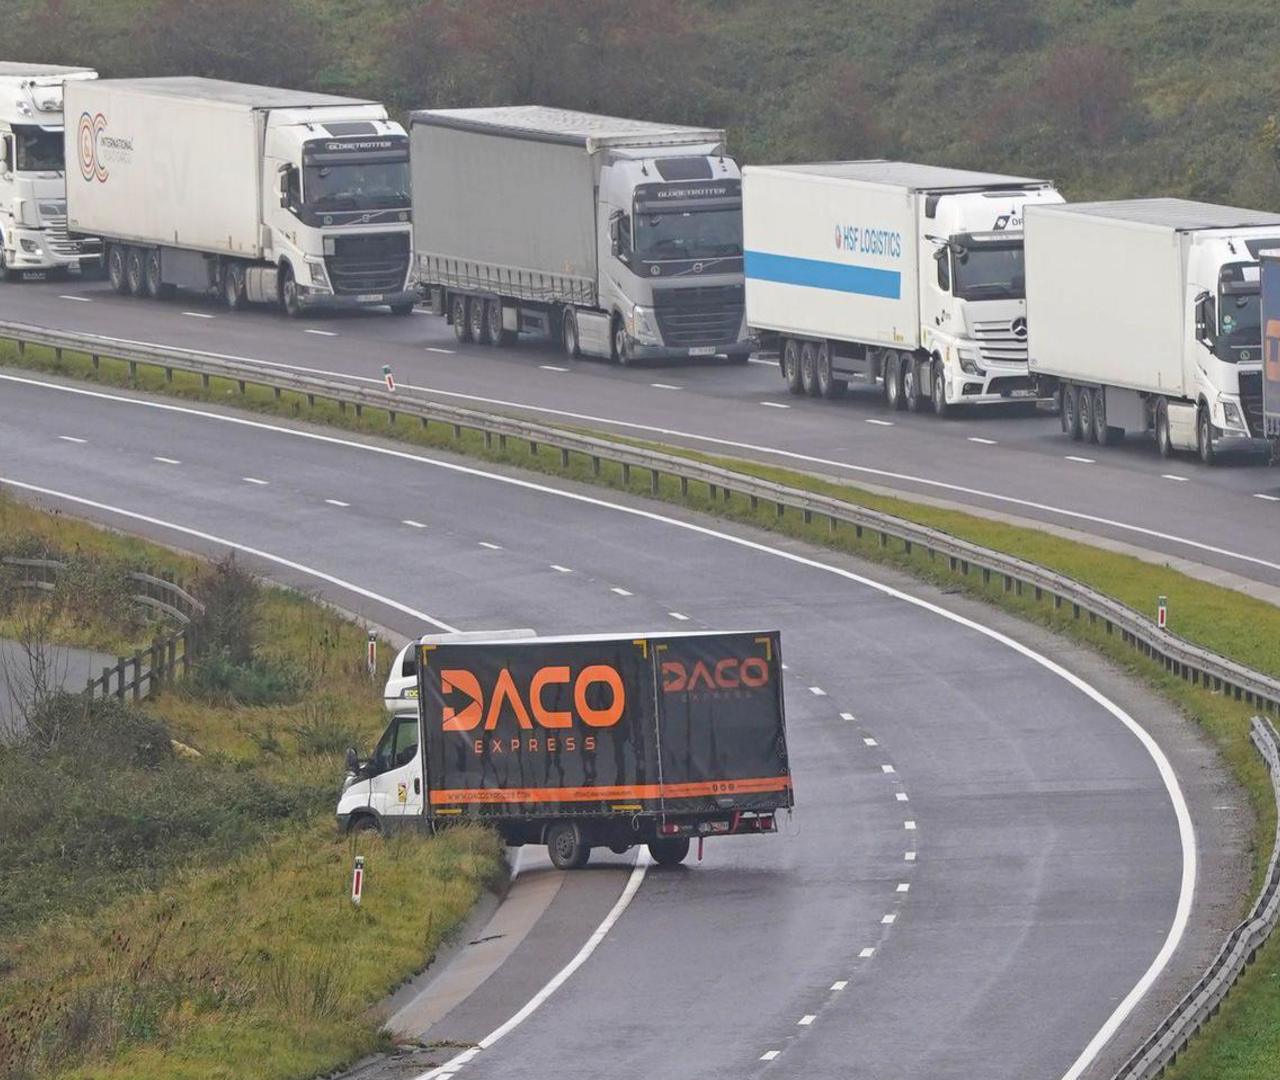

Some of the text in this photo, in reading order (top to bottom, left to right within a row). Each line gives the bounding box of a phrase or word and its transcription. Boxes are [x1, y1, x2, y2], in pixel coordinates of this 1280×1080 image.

[326, 141, 392, 150] GLOBETROTTER
[657, 188, 727, 198] GLOBETROTTER
[843, 225, 901, 258] HSF LOGISTICS
[661, 656, 769, 692] DACO
[440, 664, 625, 731] DACO
[474, 736, 596, 754] EXPRESS
